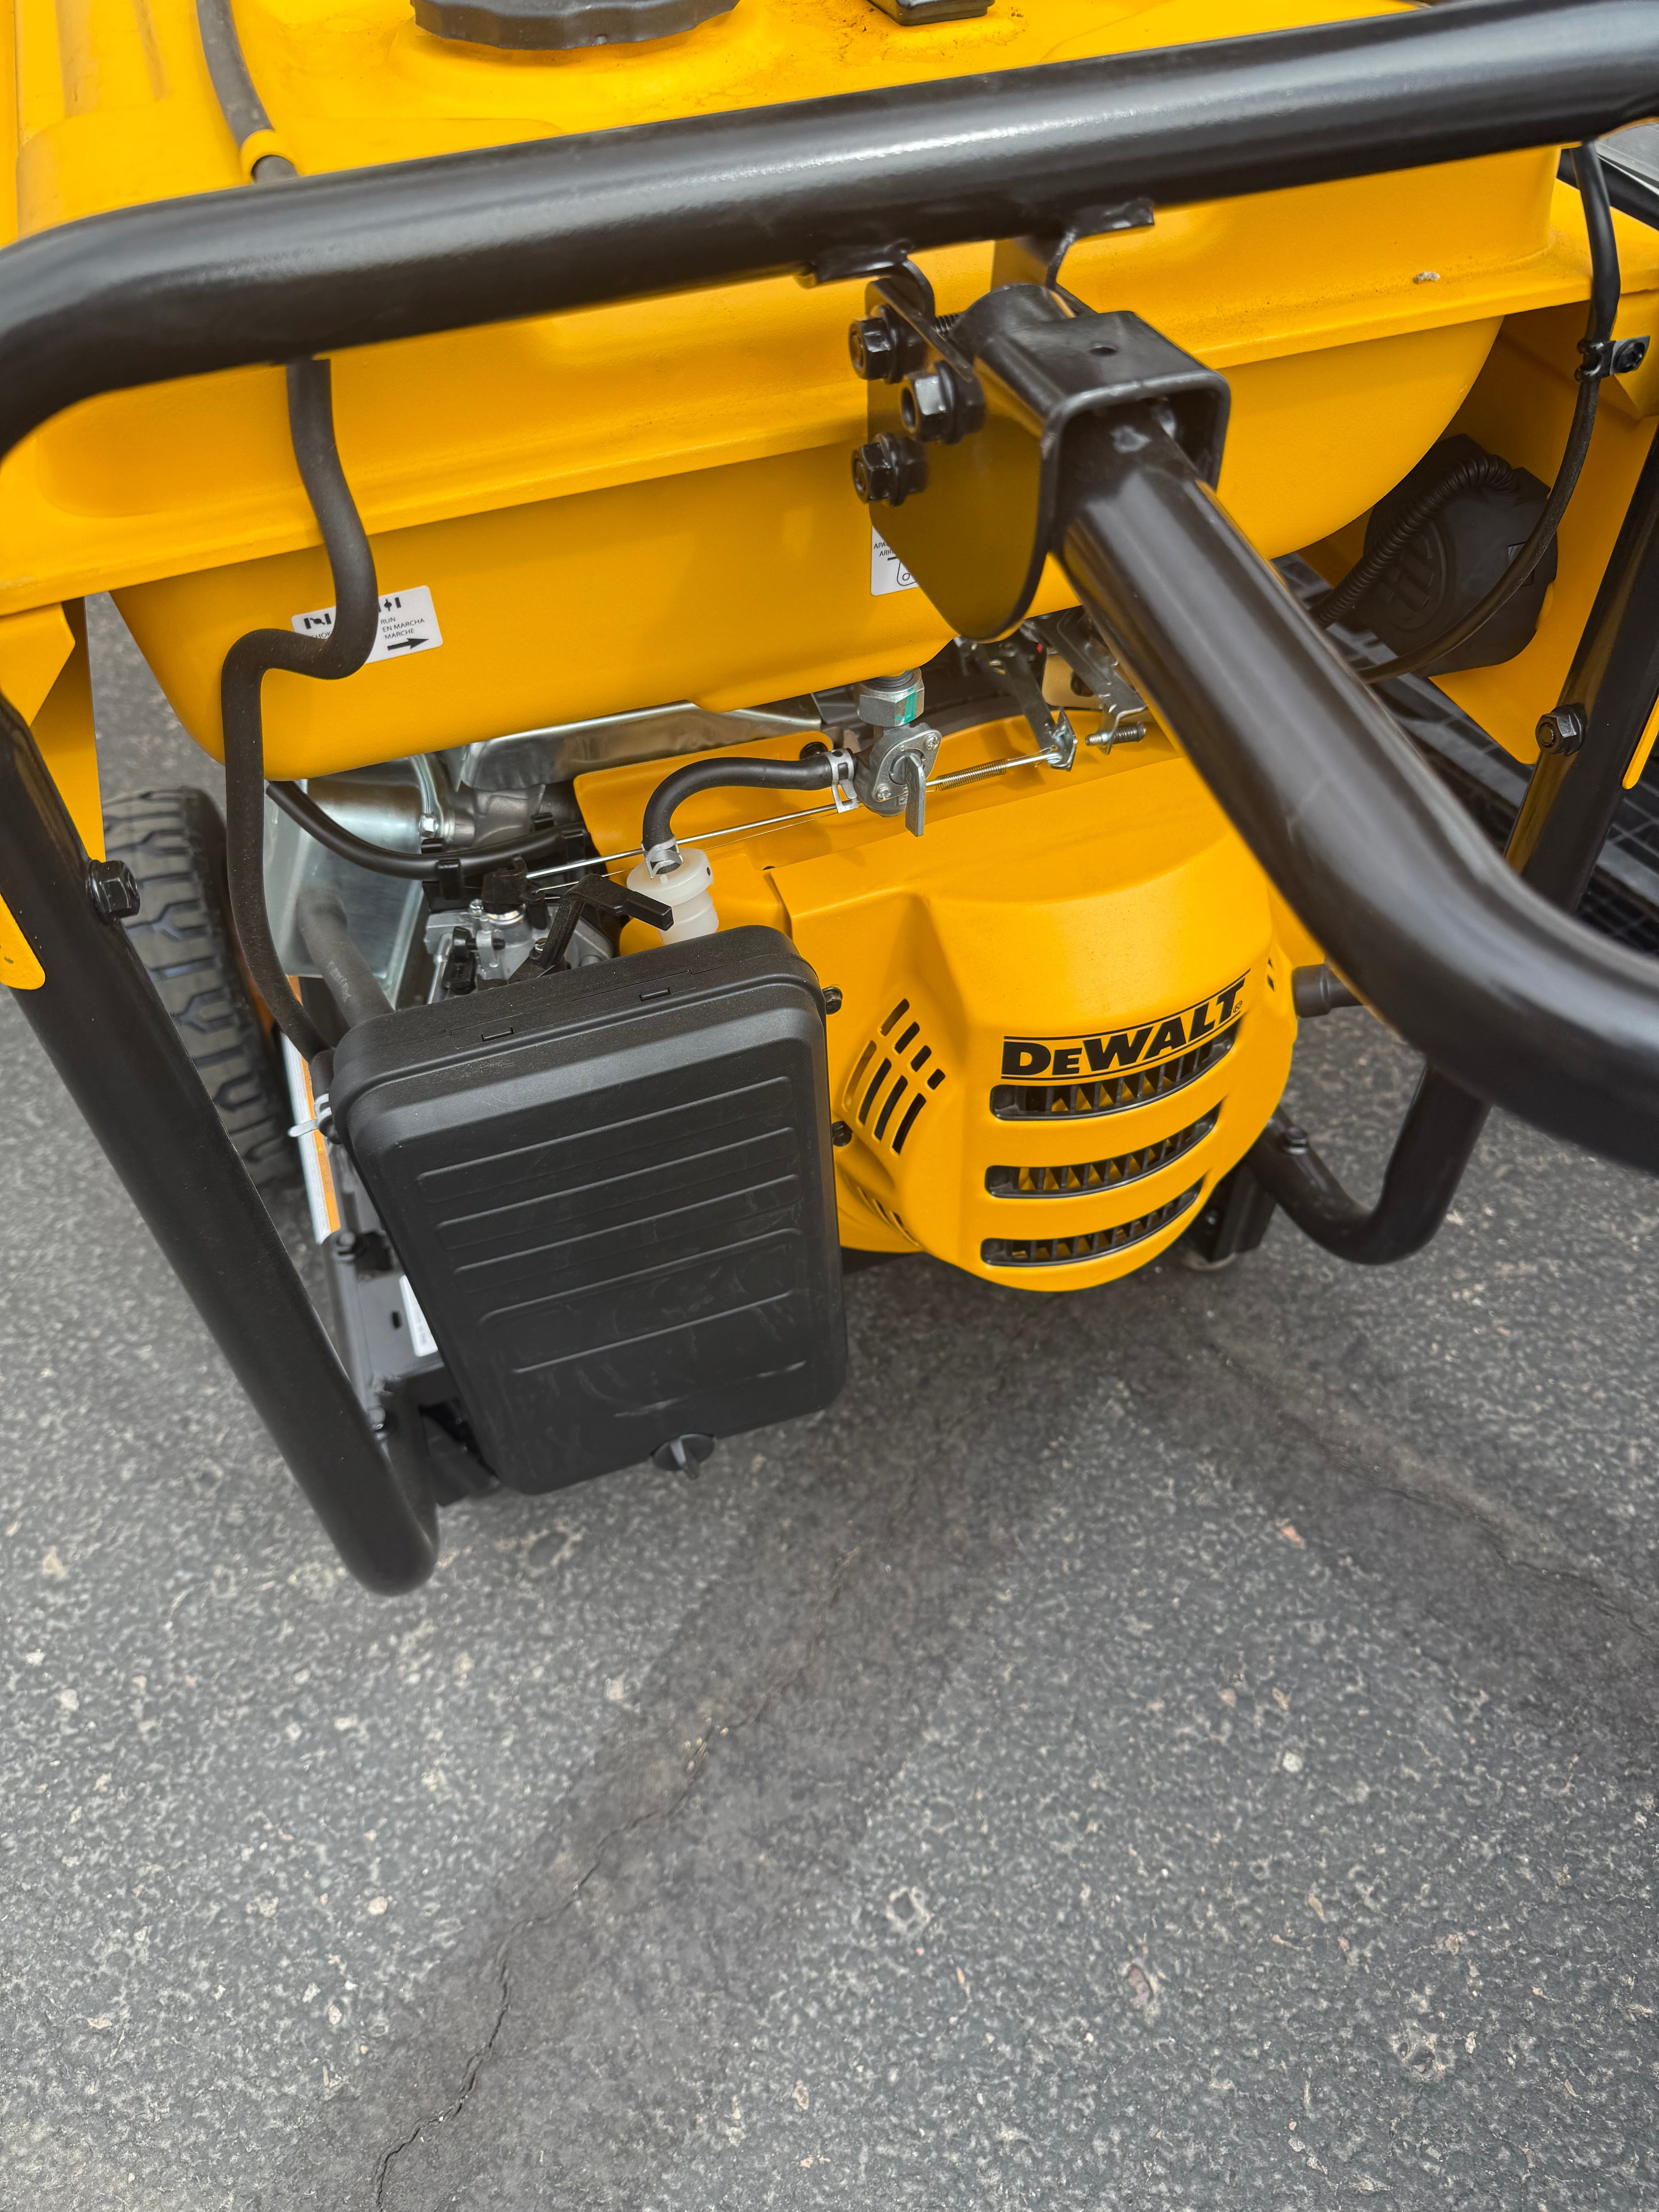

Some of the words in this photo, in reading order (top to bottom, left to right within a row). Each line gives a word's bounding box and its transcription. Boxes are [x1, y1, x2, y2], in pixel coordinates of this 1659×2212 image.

[879, 549, 894, 557] ARR
[394, 618, 425, 630] MARCHA
[385, 628, 415, 639] MARCHE
